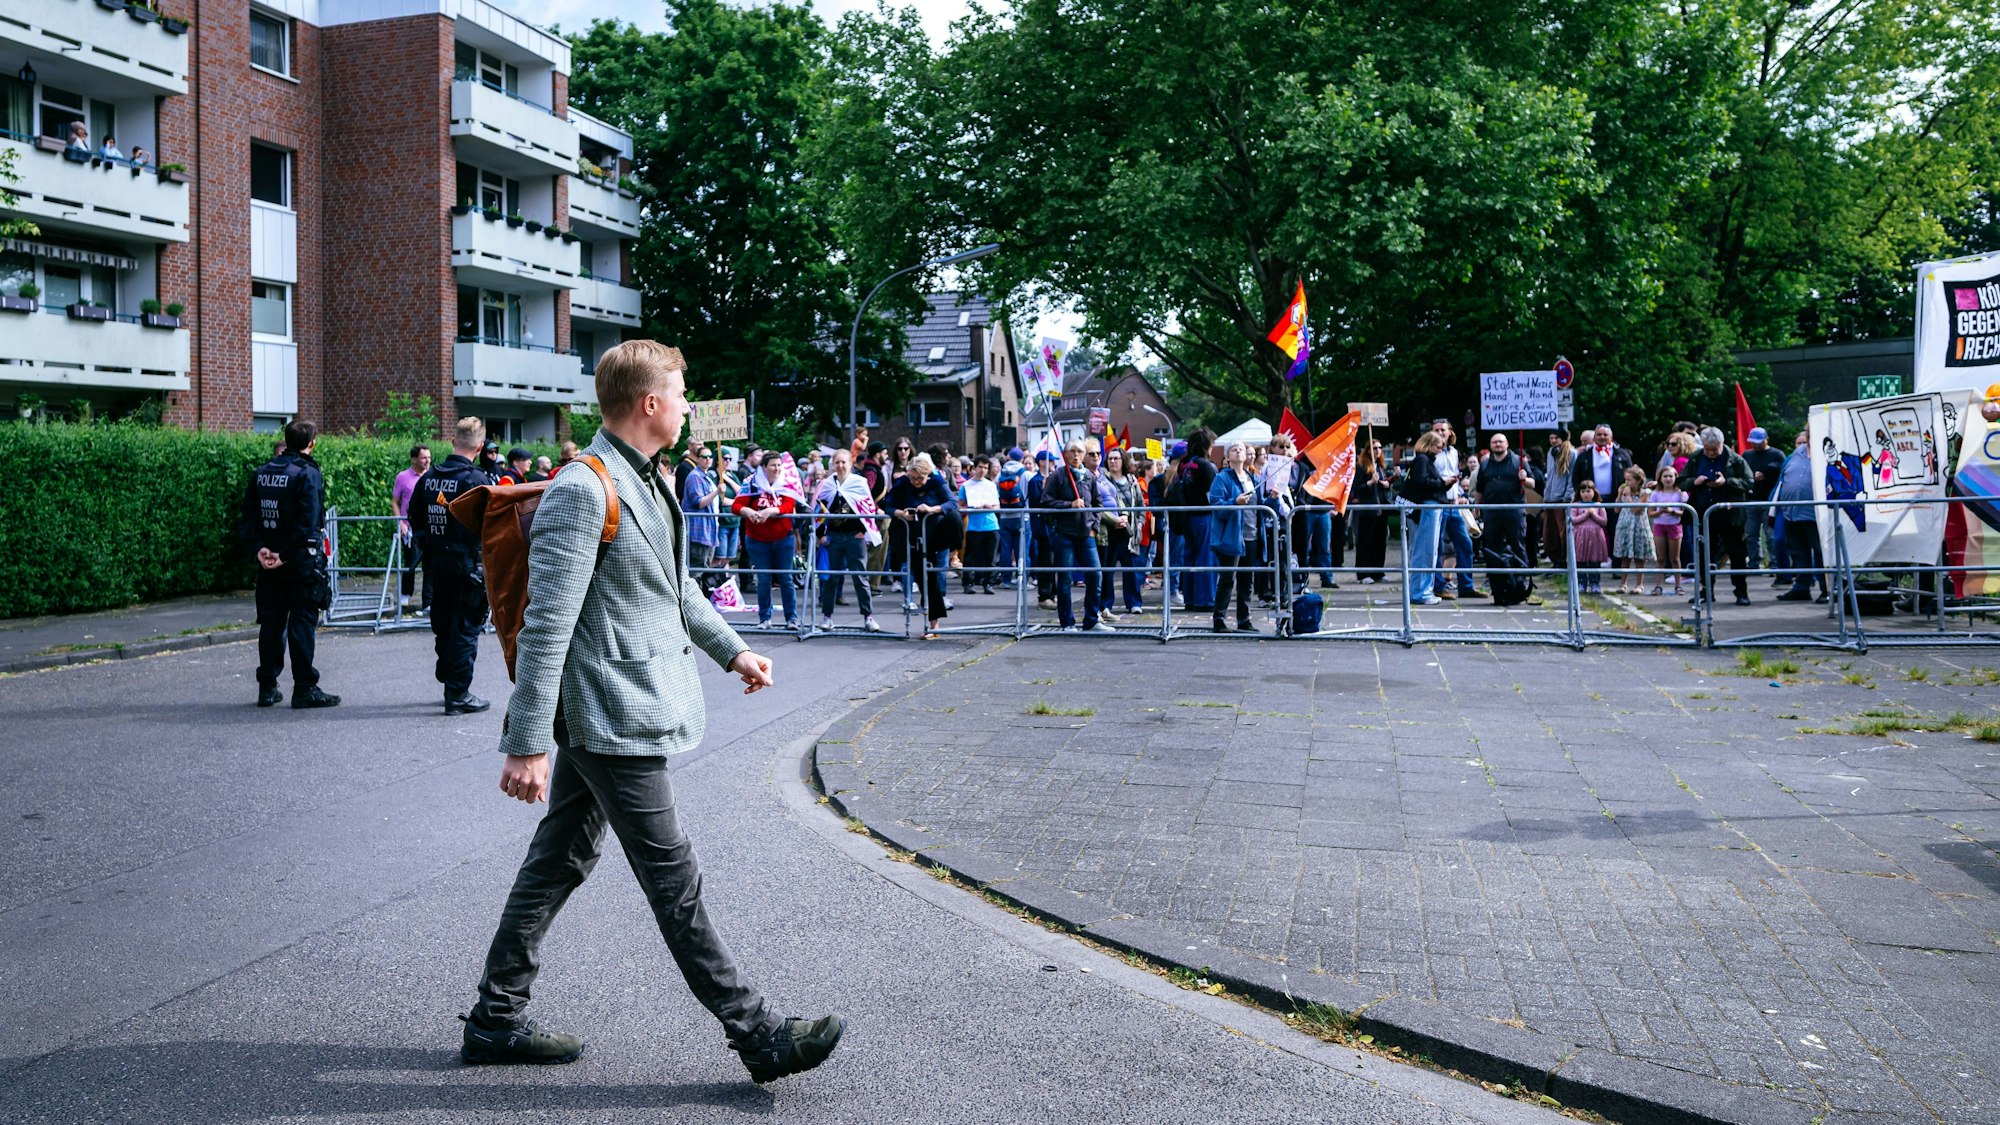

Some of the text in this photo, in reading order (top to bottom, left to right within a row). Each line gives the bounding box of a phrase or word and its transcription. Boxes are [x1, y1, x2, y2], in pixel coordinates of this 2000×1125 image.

[1484, 376, 1553, 391] Stadt und Nazis
[1484, 389, 1553, 401] Hand in Hand
[257, 474, 289, 487] POLIZEI
[425, 478, 458, 493] POLIZEI
[261, 499, 278, 509] NRW
[428, 504, 446, 514] NRW
[261, 509, 279, 519] 31331
[428, 514, 447, 524] 31331
[430, 525, 445, 535] FLT
